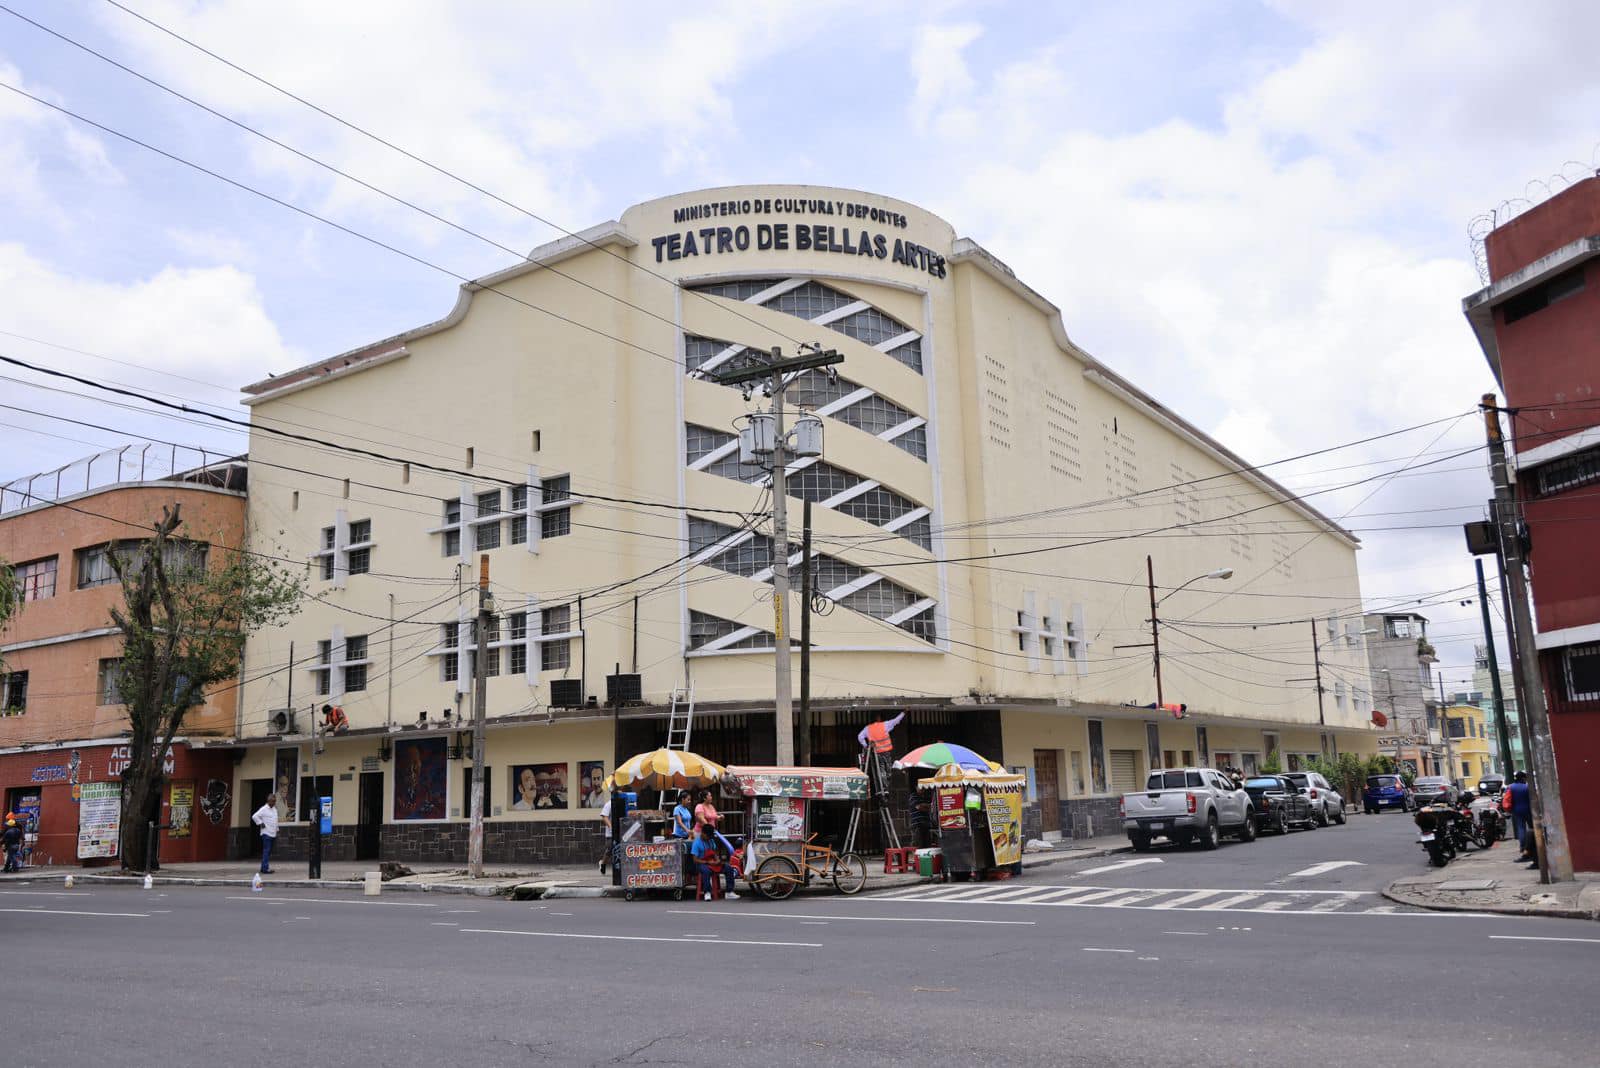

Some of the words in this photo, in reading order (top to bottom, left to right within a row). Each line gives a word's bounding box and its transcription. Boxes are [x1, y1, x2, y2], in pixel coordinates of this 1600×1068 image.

[673, 200, 751, 223] MINISTERIO
[754, 199, 771, 214] DE
[774, 198, 834, 215] CULTURA
[835, 201, 843, 216] Y
[846, 203, 908, 228] DEPORTES
[651, 225, 750, 263] TEATRO
[757, 223, 789, 250] DE
[795, 224, 888, 260] BELLAS
[892, 238, 947, 280] ARTES
